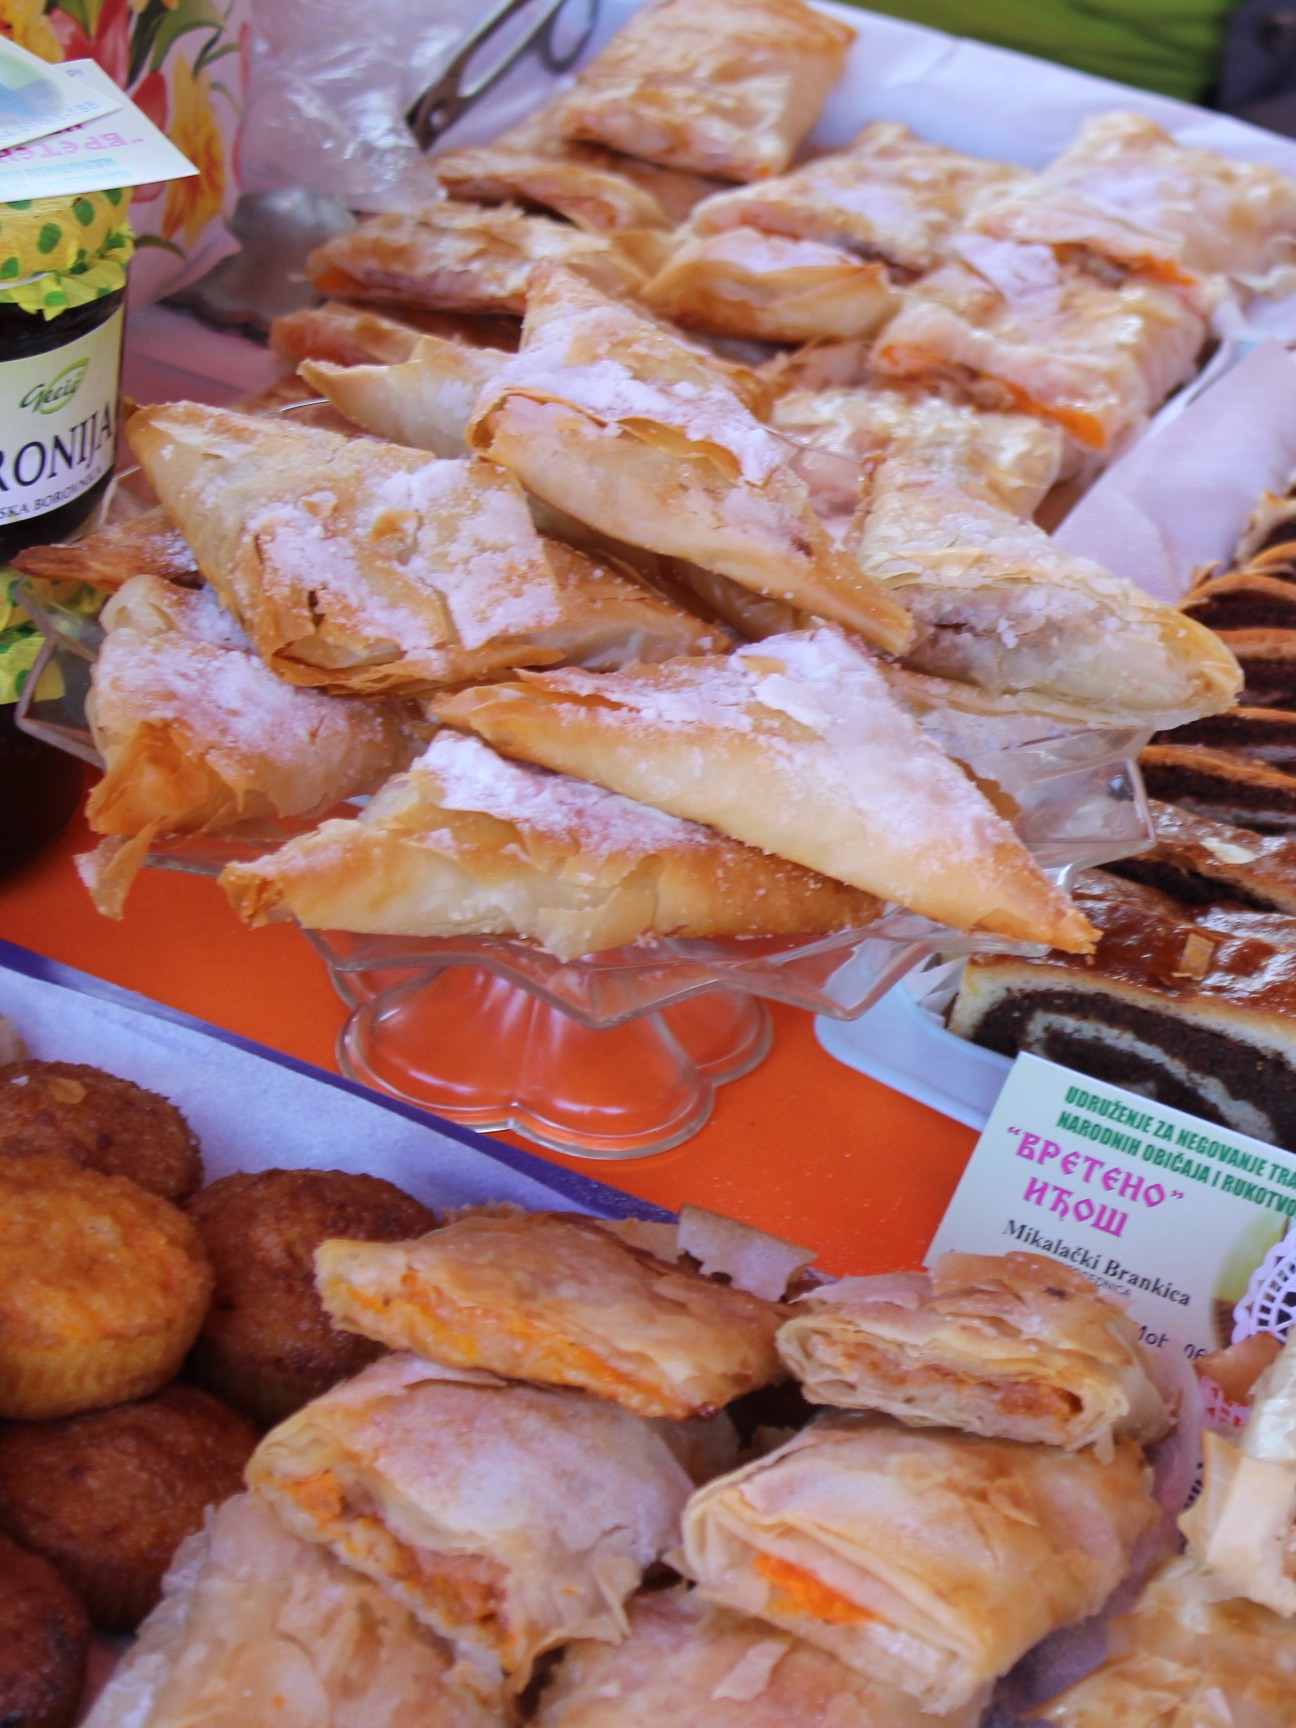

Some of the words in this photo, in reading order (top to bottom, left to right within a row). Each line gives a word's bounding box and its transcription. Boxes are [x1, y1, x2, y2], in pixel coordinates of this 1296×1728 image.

[1055, 1110, 1142, 1157] NARODNIH
[1211, 1170, 1221, 1187] I
[1065, 1086, 1155, 1133] UDRUŽENJE
[1152, 1120, 1175, 1142] ZA
[1176, 1129, 1267, 1176] NEGOVANJE
[1001, 1219, 1102, 1271] Mikalački
[1104, 1259, 1191, 1306] Brankica
